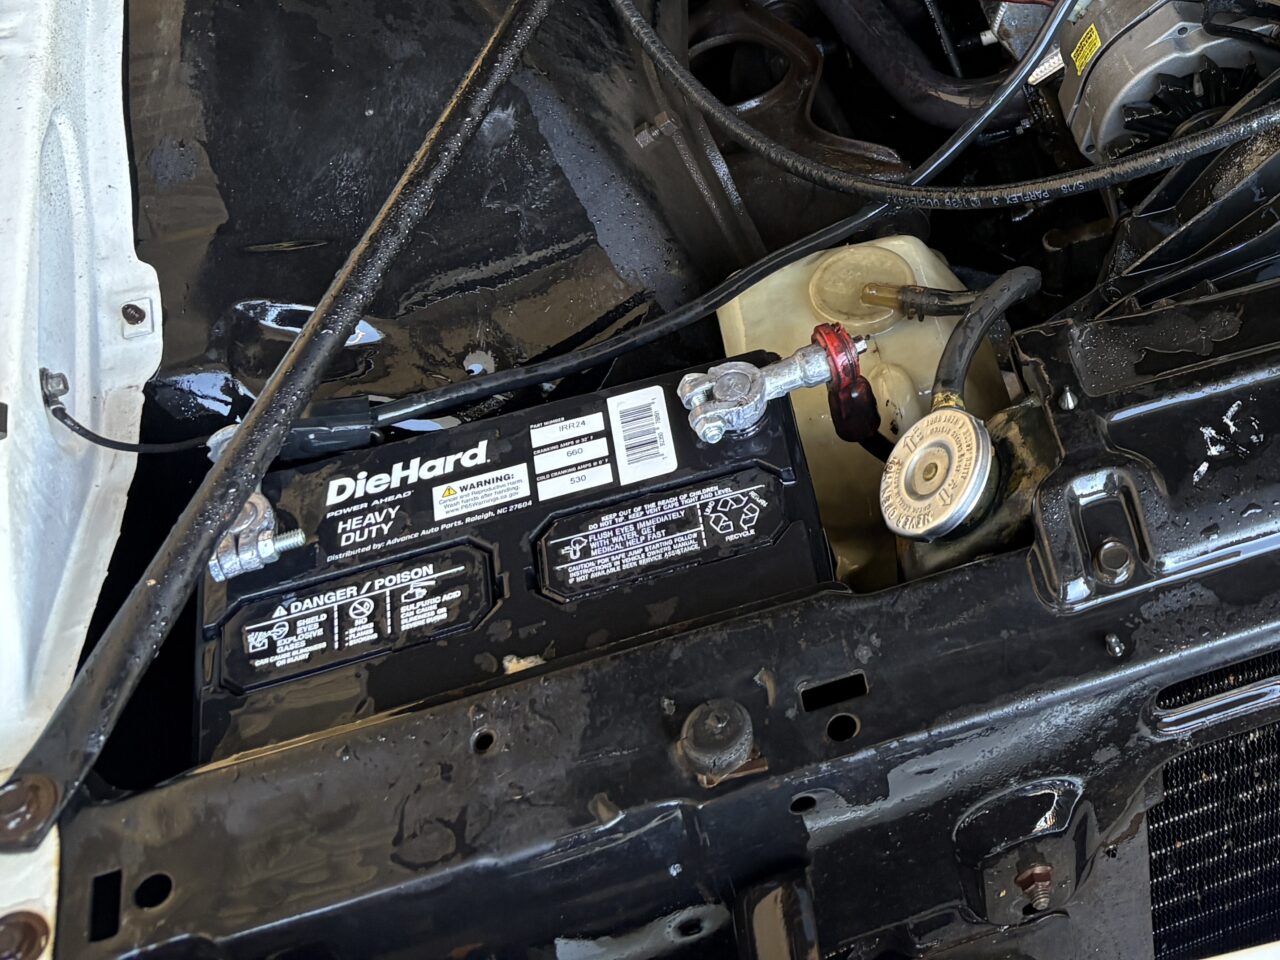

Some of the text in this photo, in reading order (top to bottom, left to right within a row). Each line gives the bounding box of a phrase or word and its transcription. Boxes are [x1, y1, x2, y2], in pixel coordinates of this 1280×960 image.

[1005, 189, 1050, 205] PARFLEX
[559, 420, 586, 432] IRR24
[566, 447, 584, 457] 660
[325, 440, 489, 506] DieHard
[459, 473, 515, 492] WARNING:
[570, 474, 587, 485] 530
[326, 492, 412, 520] POWER AHEAD
[588, 523, 598, 531] DO
[600, 520, 613, 528] NOT
[628, 511, 644, 520] KEEP
[646, 506, 663, 515] VENT
[664, 502, 679, 510] CAPS
[681, 497, 698, 506] TIGHT
[700, 492, 714, 500] AND
[714, 487, 733, 497] LEVEL
[601, 512, 617, 521] KEEP
[618, 509, 632, 517] OUT
[643, 502, 656, 510] THE
[657, 497, 678, 506] REACH
[688, 485, 719, 498] CHILDREN
[880, 481, 898, 520] OPEN
[337, 505, 401, 534] HEAVY
[588, 510, 686, 542] FLUSH EYES IMMEDIATELY
[896, 510, 934, 530] NEVER
[326, 545, 372, 563] Distributed
[373, 541, 385, 551] by:
[386, 532, 419, 546] Advance
[420, 526, 440, 537] Auto
[465, 511, 496, 526] Raleigh,
[496, 507, 508, 515] NC
[509, 500, 533, 512] 27604
[340, 521, 394, 546] DUTY
[589, 539, 609, 549] WITH
[641, 525, 656, 535] GET
[590, 529, 666, 556] MEDICAL HELP FAST
[725, 528, 756, 542] RECYCLE
[597, 557, 610, 565] FOR
[611, 553, 626, 562] SAFE
[627, 549, 643, 557] JUMP
[645, 540, 673, 552] STARTING
[674, 532, 698, 544] FOLLOW
[569, 564, 612, 578] INSTRUCTIONS
[621, 553, 645, 564] VEHICLE
[646, 546, 671, 557] OWNERS
[576, 575, 589, 583] NOT
[590, 566, 621, 579] AVAILABLE
[290, 586, 358, 614] DANGER
[374, 564, 433, 590] POISON
[442, 590, 461, 602] ACID
[296, 613, 327, 628] SHIELD
[296, 623, 320, 635] EYES
[354, 617, 368, 627] NO
[276, 628, 324, 647] EXPLOSIVE
[276, 640, 306, 654] GASES
